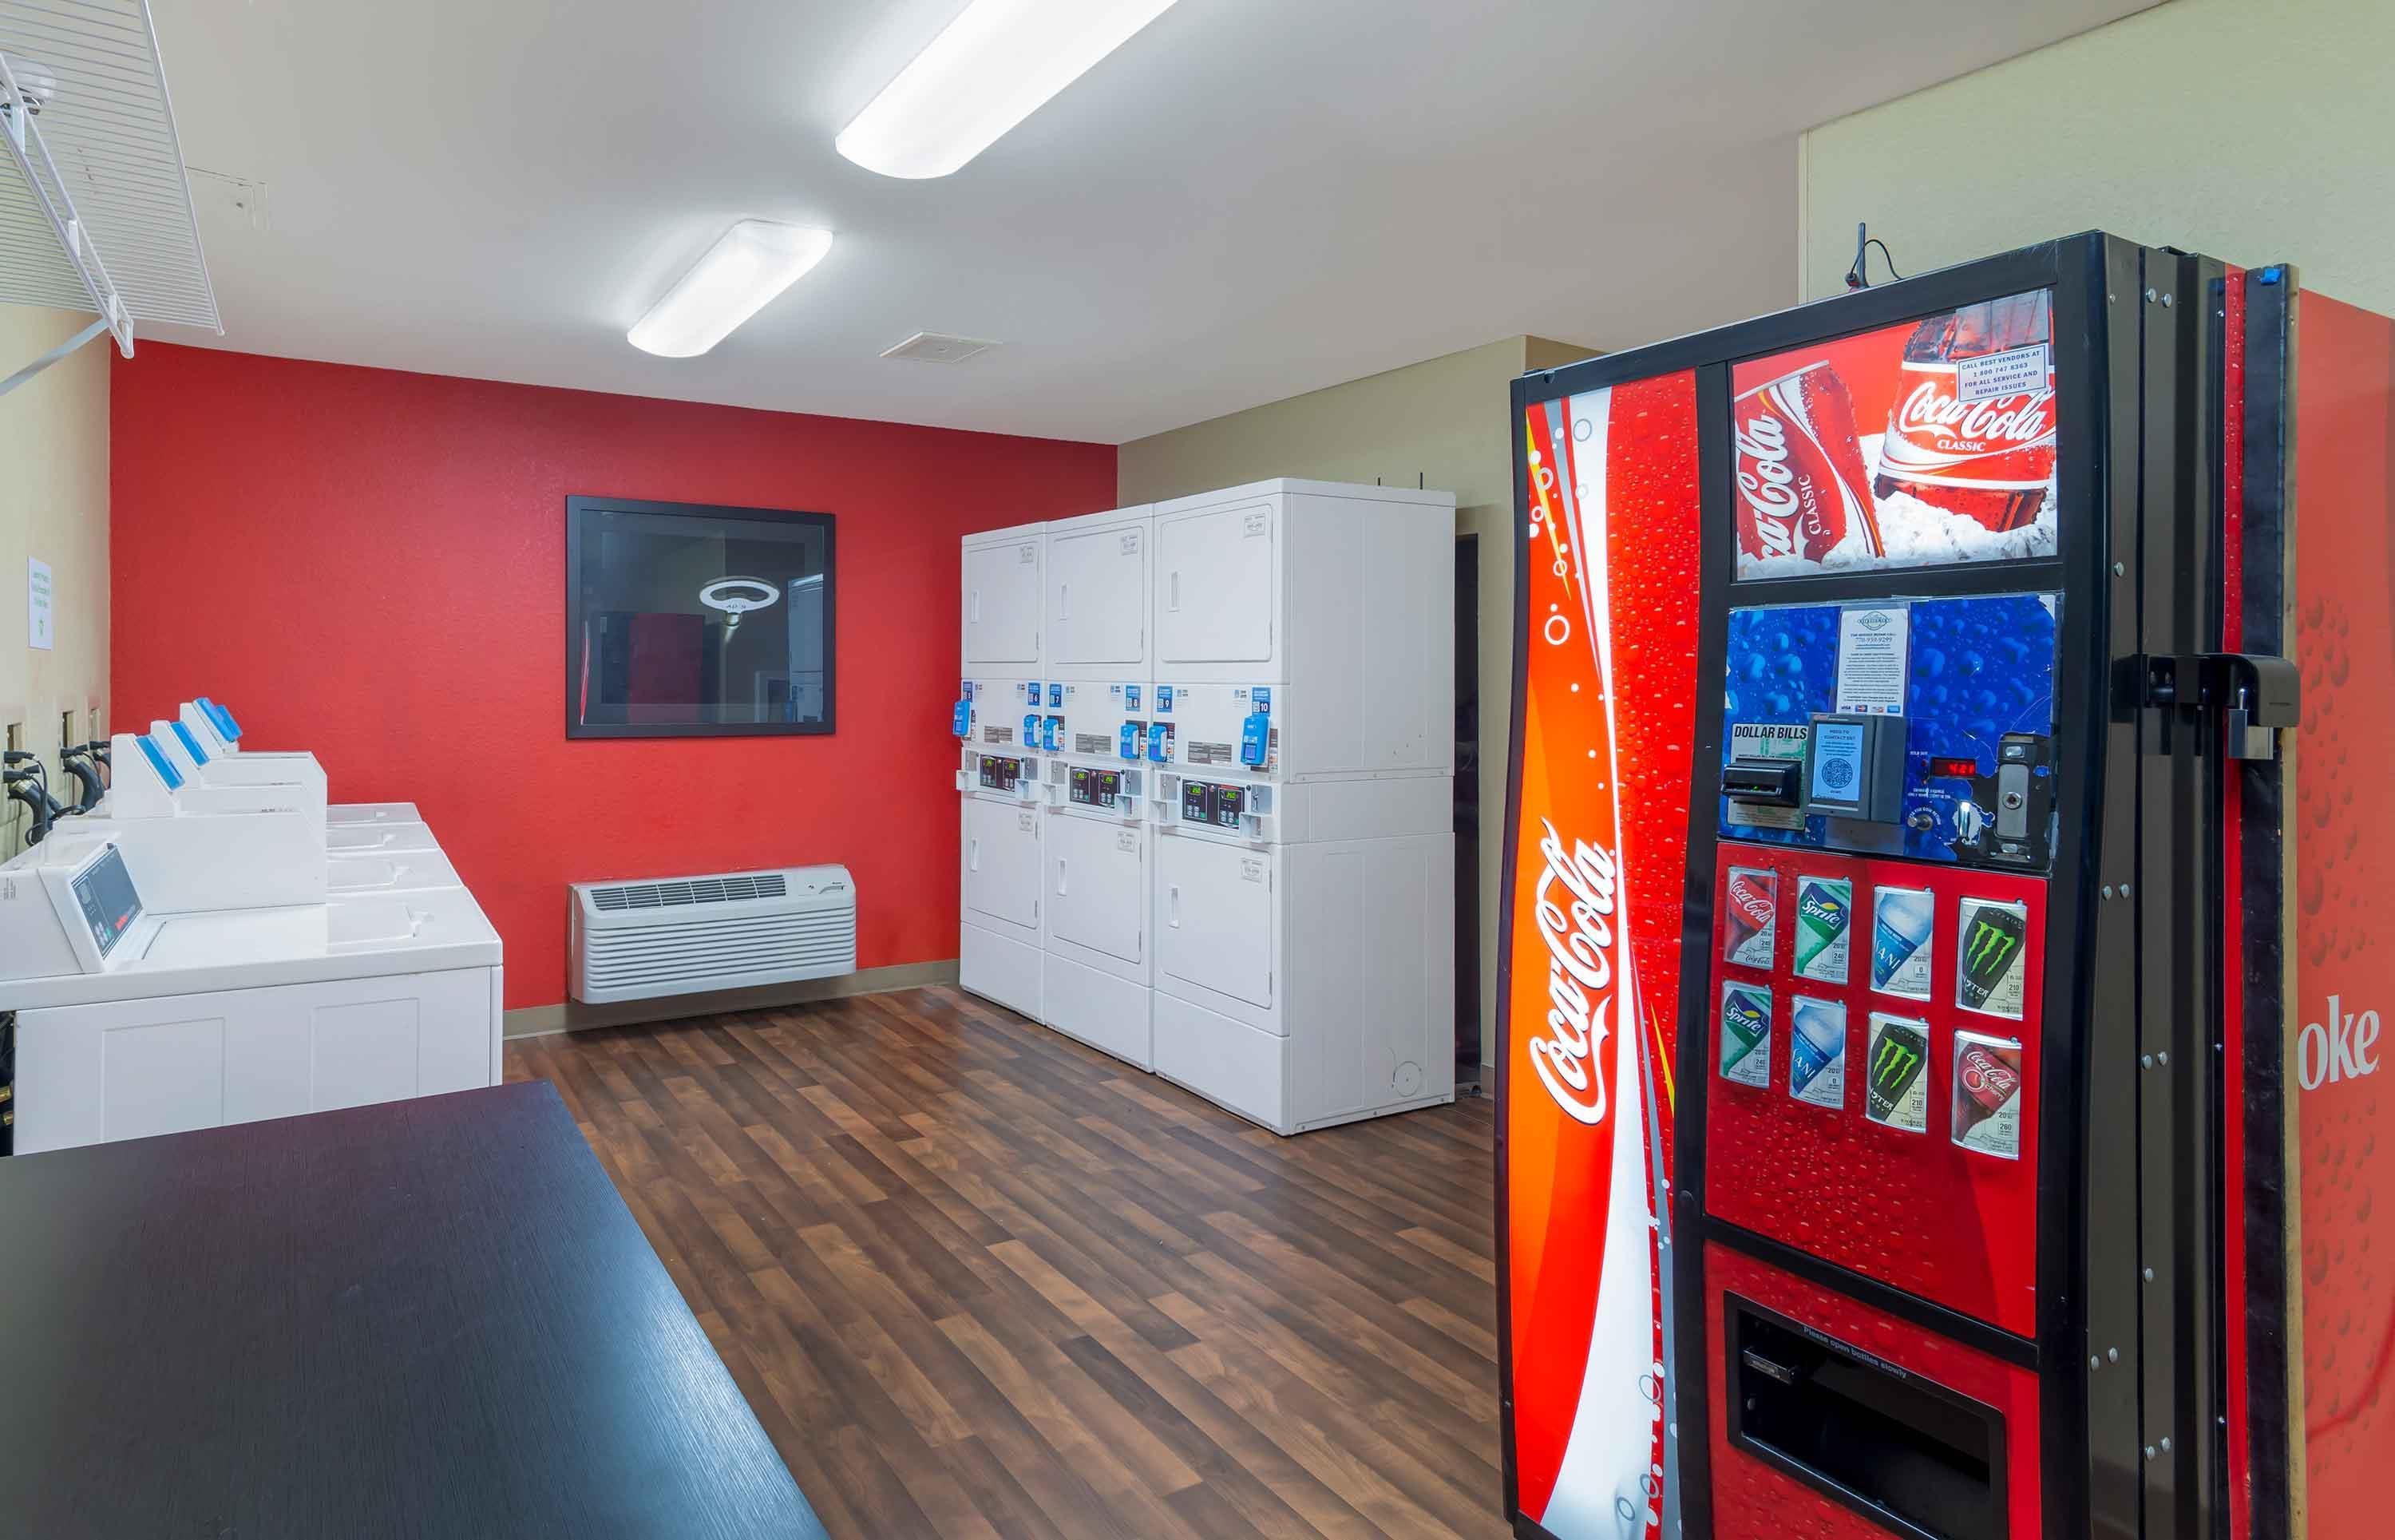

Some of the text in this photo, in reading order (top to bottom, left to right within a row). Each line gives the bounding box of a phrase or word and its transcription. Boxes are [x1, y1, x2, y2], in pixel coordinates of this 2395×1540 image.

[1998, 352, 2030, 363] VENDORS
[1975, 382, 2026, 395] REPAIR ISSUES
[1993, 373, 2021, 382] SERVICE
[1937, 439, 1986, 452] CLASSIC
[1798, 476, 1822, 536] CLASSIC
[1260, 703, 1268, 712] 10
[1734, 726, 1807, 739] DOLLAR BILLS
[1730, 881, 1775, 923] Coca-Cola
[1802, 899, 1840, 923] Sprite
[1529, 817, 1616, 1126] Coca-Cola
[1726, 1008, 1763, 1031] Sprite
[2298, 995, 2380, 1091] oke
[1967, 1051, 2017, 1089] Coca-Cola
[1985, 1083, 2005, 1102] cherry
[1804, 1326, 1906, 1379] Please open bottles slowly
